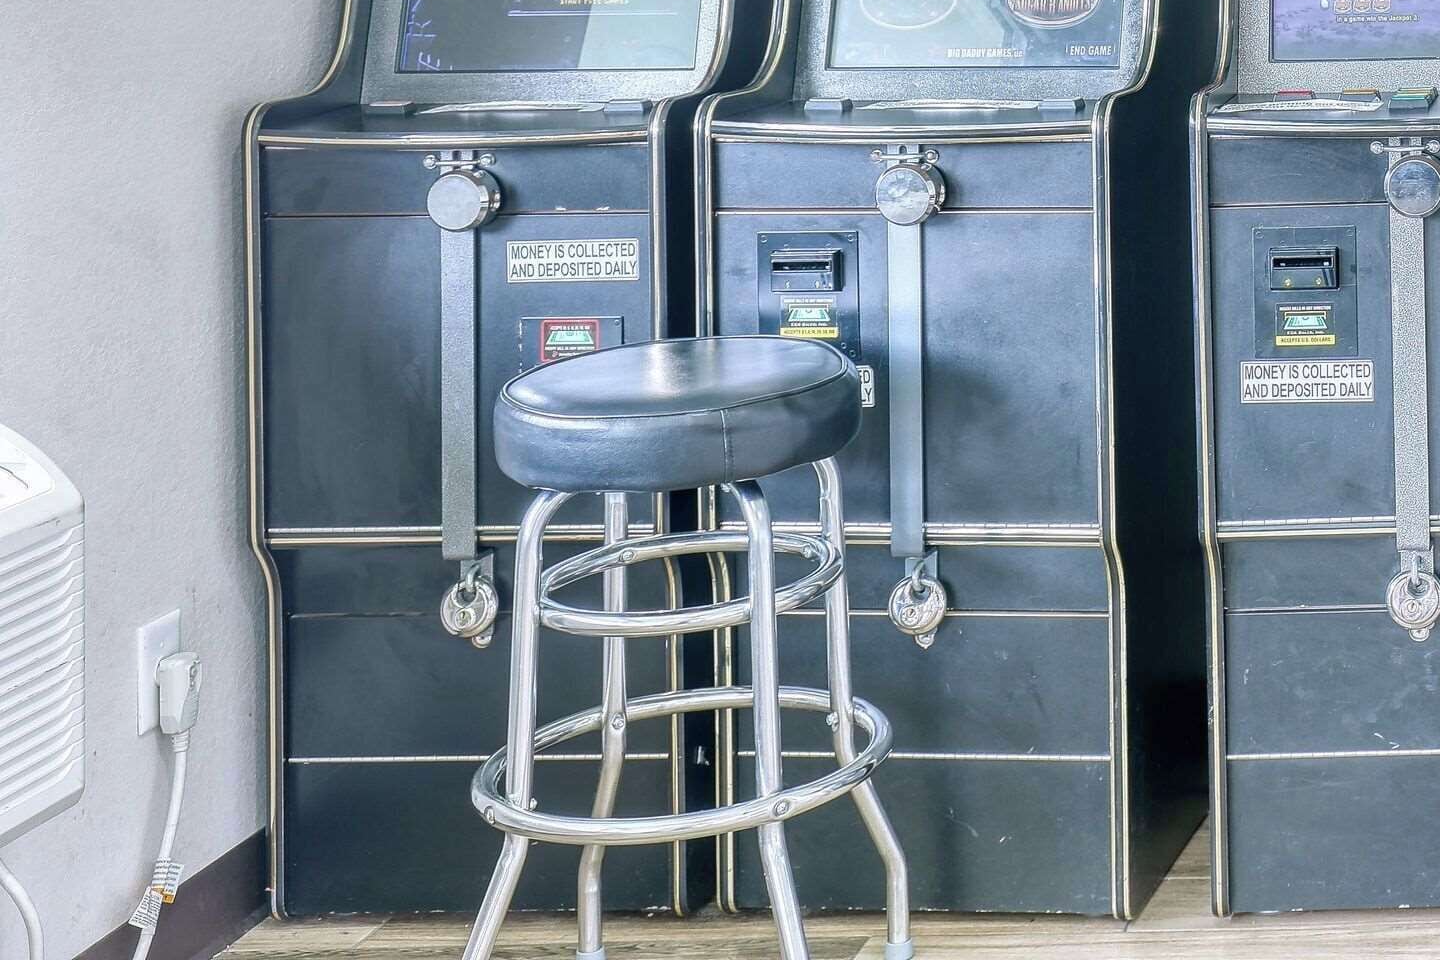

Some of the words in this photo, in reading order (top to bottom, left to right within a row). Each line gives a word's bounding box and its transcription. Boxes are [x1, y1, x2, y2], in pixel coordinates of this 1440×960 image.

[1070, 46, 1087, 56] END
[1088, 45, 1113, 56] GAME
[510, 245, 552, 260] MONEY
[554, 244, 565, 259] IS
[567, 243, 636, 258] COLLECTED
[510, 263, 536, 278] AND
[538, 262, 602, 277] DEPOSITED
[604, 261, 637, 276] DAILY
[1244, 365, 1288, 380] MONEY
[1288, 365, 1299, 379] IS
[1302, 364, 1371, 379] COLLECTED
[1244, 383, 1269, 398] AND
[1271, 383, 1337, 398] DEPOSITED
[1339, 382, 1373, 397] DAILY
